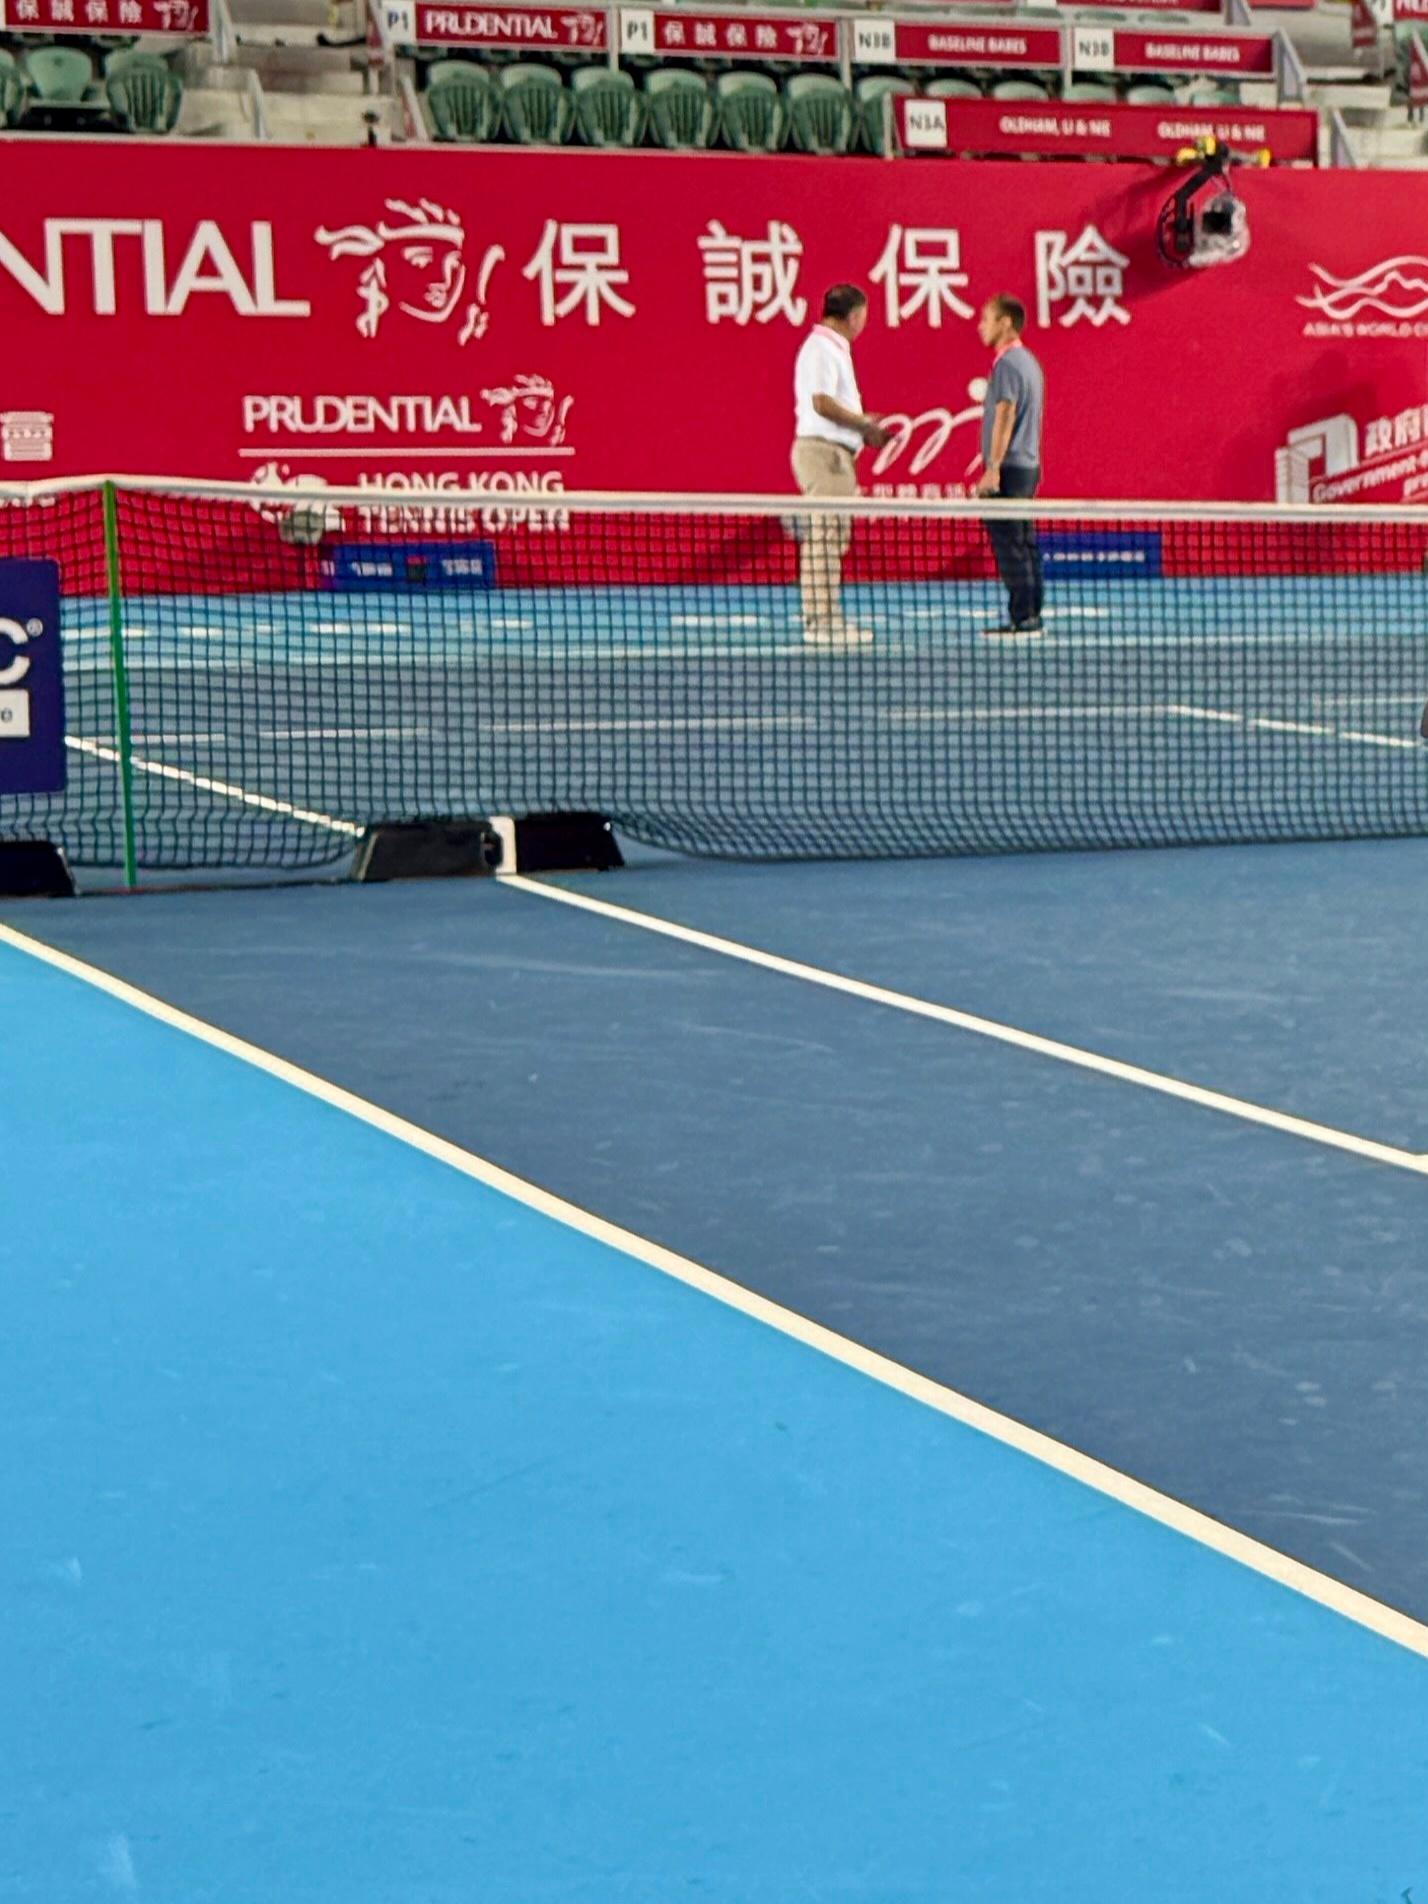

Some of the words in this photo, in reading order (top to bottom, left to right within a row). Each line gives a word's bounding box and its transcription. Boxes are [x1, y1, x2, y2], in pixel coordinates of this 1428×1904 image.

[387, 10, 409, 32] P1
[424, 12, 558, 40] PRUDENTIAL
[626, 22, 649, 42] P1
[523, 217, 1131, 329] 保誠保險
[242, 395, 483, 434] PRUDENTIAL
